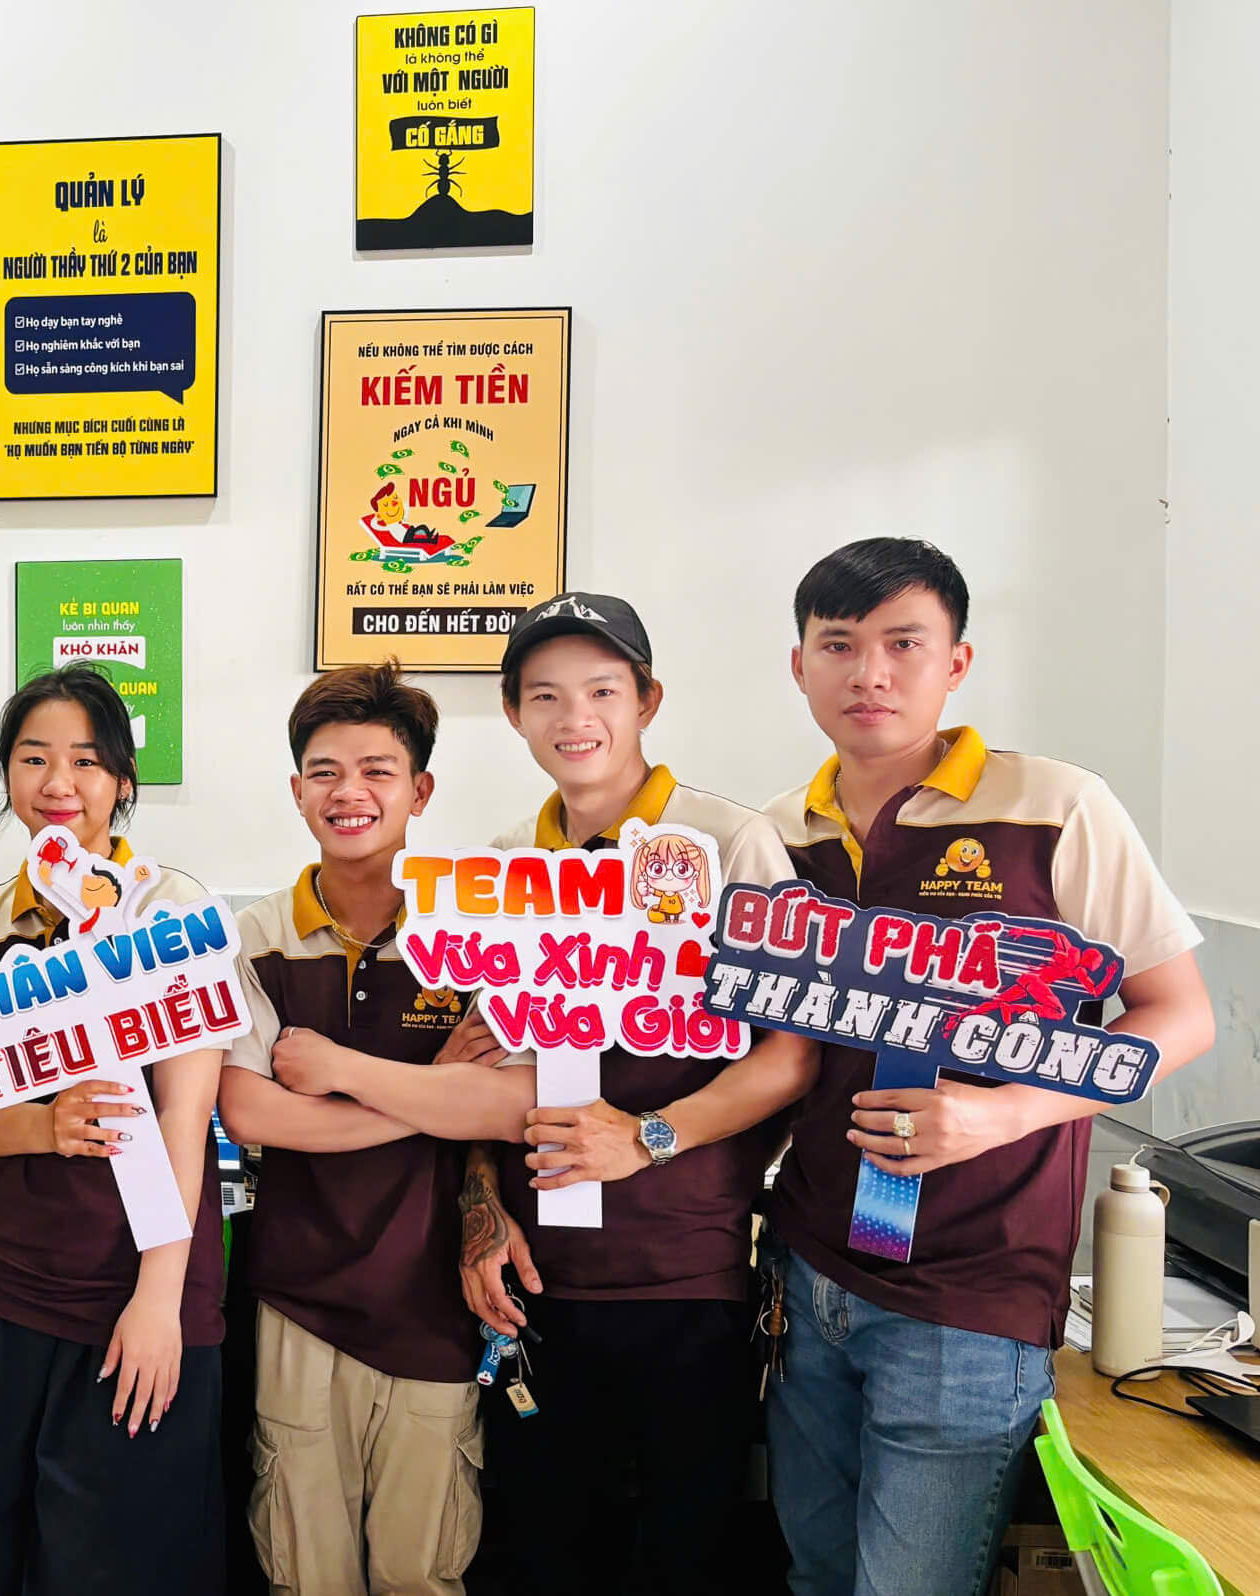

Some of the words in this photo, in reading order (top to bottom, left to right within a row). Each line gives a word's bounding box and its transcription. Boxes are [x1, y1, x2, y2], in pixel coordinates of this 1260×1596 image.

[394, 24, 450, 48] KHÔNG
[455, 20, 476, 45] CÓ
[481, 19, 498, 44] GÌ
[420, 53, 460, 65] không
[464, 48, 484, 62] thể
[382, 69, 408, 94] VỚI
[413, 68, 449, 96] MỘT
[459, 65, 509, 91] NGƯỜI
[417, 99, 444, 111] luôn
[448, 97, 471, 109] biết
[405, 121, 430, 147] CỐ
[435, 119, 484, 146] GẮNG
[55, 171, 114, 211] QUẢN
[121, 173, 145, 206] LÝ
[93, 219, 108, 243] là
[3, 251, 46, 279] NGƯỜI
[51, 247, 86, 278] THẦY
[90, 250, 117, 277] THỨ
[121, 254, 130, 276] 2
[135, 246, 163, 275] CỦA
[168, 251, 197, 279] BẠN
[26, 317, 39, 330] Họ
[41, 316, 58, 329] dạy
[60, 316, 79, 330] bạn
[81, 316, 96, 328] tay
[98, 312, 123, 327] nghề
[26, 341, 39, 353] Họ
[41, 339, 78, 352] nghiêm
[80, 337, 103, 349] khắc
[105, 337, 120, 349] với
[122, 337, 140, 351] bạn
[358, 342, 378, 358] NẾU
[383, 342, 419, 357] KHÔNG
[423, 340, 444, 356] THỂ
[447, 342, 466, 356] TÌM
[470, 342, 500, 358] ĐƯỢC
[504, 341, 533, 355] CÁCH
[26, 364, 39, 376] Họ
[41, 361, 58, 374] sẵn
[60, 362, 82, 375] sàng
[84, 361, 108, 375] công
[110, 361, 130, 373] kích
[132, 360, 148, 371] khi
[150, 360, 168, 374] bạn
[170, 359, 184, 370] sai
[361, 365, 442, 406] KIẾM
[455, 363, 528, 404] TIỀN
[54, 420, 79, 437] MỤC
[83, 417, 108, 433] ĐÍCH
[111, 415, 136, 432] CUỐI
[139, 416, 169, 432] CÙNG
[172, 415, 185, 431] LÀ
[393, 420, 421, 443] NGAY
[425, 414, 440, 430] CẢ
[443, 417, 462, 430] KHI
[465, 419, 494, 441] MÌNH
[24, 439, 57, 456] MUỐN
[60, 442, 82, 459] BẠN
[85, 439, 109, 456] TIẾN
[112, 440, 126, 458] BỘ
[409, 468, 475, 508] NGỦ
[346, 580, 366, 595] RẤT
[370, 581, 385, 595] CÓ
[388, 579, 409, 595] THỂ
[412, 584, 433, 598] BẠN
[454, 580, 479, 595] PHẢI
[483, 581, 505, 595] LÀM
[509, 581, 534, 597] VIỆC
[83, 602, 97, 616] BI
[101, 601, 140, 616] QUAN
[363, 614, 399, 632] CHO
[405, 608, 440, 632] ĐẾN
[446, 608, 480, 632] HẾT
[485, 610, 516, 632] ĐỜI
[88, 618, 109, 631] nhìn
[60, 640, 92, 655] KHÓ
[97, 640, 138, 655] KHĂN
[119, 682, 157, 696] QUAN
[402, 856, 625, 916] TEAM
[920, 880, 962, 890] HAPPY
[965, 880, 1003, 893] TEAM
[93, 905, 229, 982] VIÊN
[724, 887, 854, 966] BỨT
[864, 914, 1005, 993] PHÁ
[406, 929, 521, 987] Vừa
[534, 930, 666, 992] Xinh
[104, 974, 241, 1061] BIỂU
[401, 1012, 438, 1024] HAPPY
[442, 1014, 462, 1025] TEA
[488, 991, 606, 1050] Vừa
[709, 962, 941, 1054] THÀNH
[950, 1012, 1149, 1097] CÔNG
